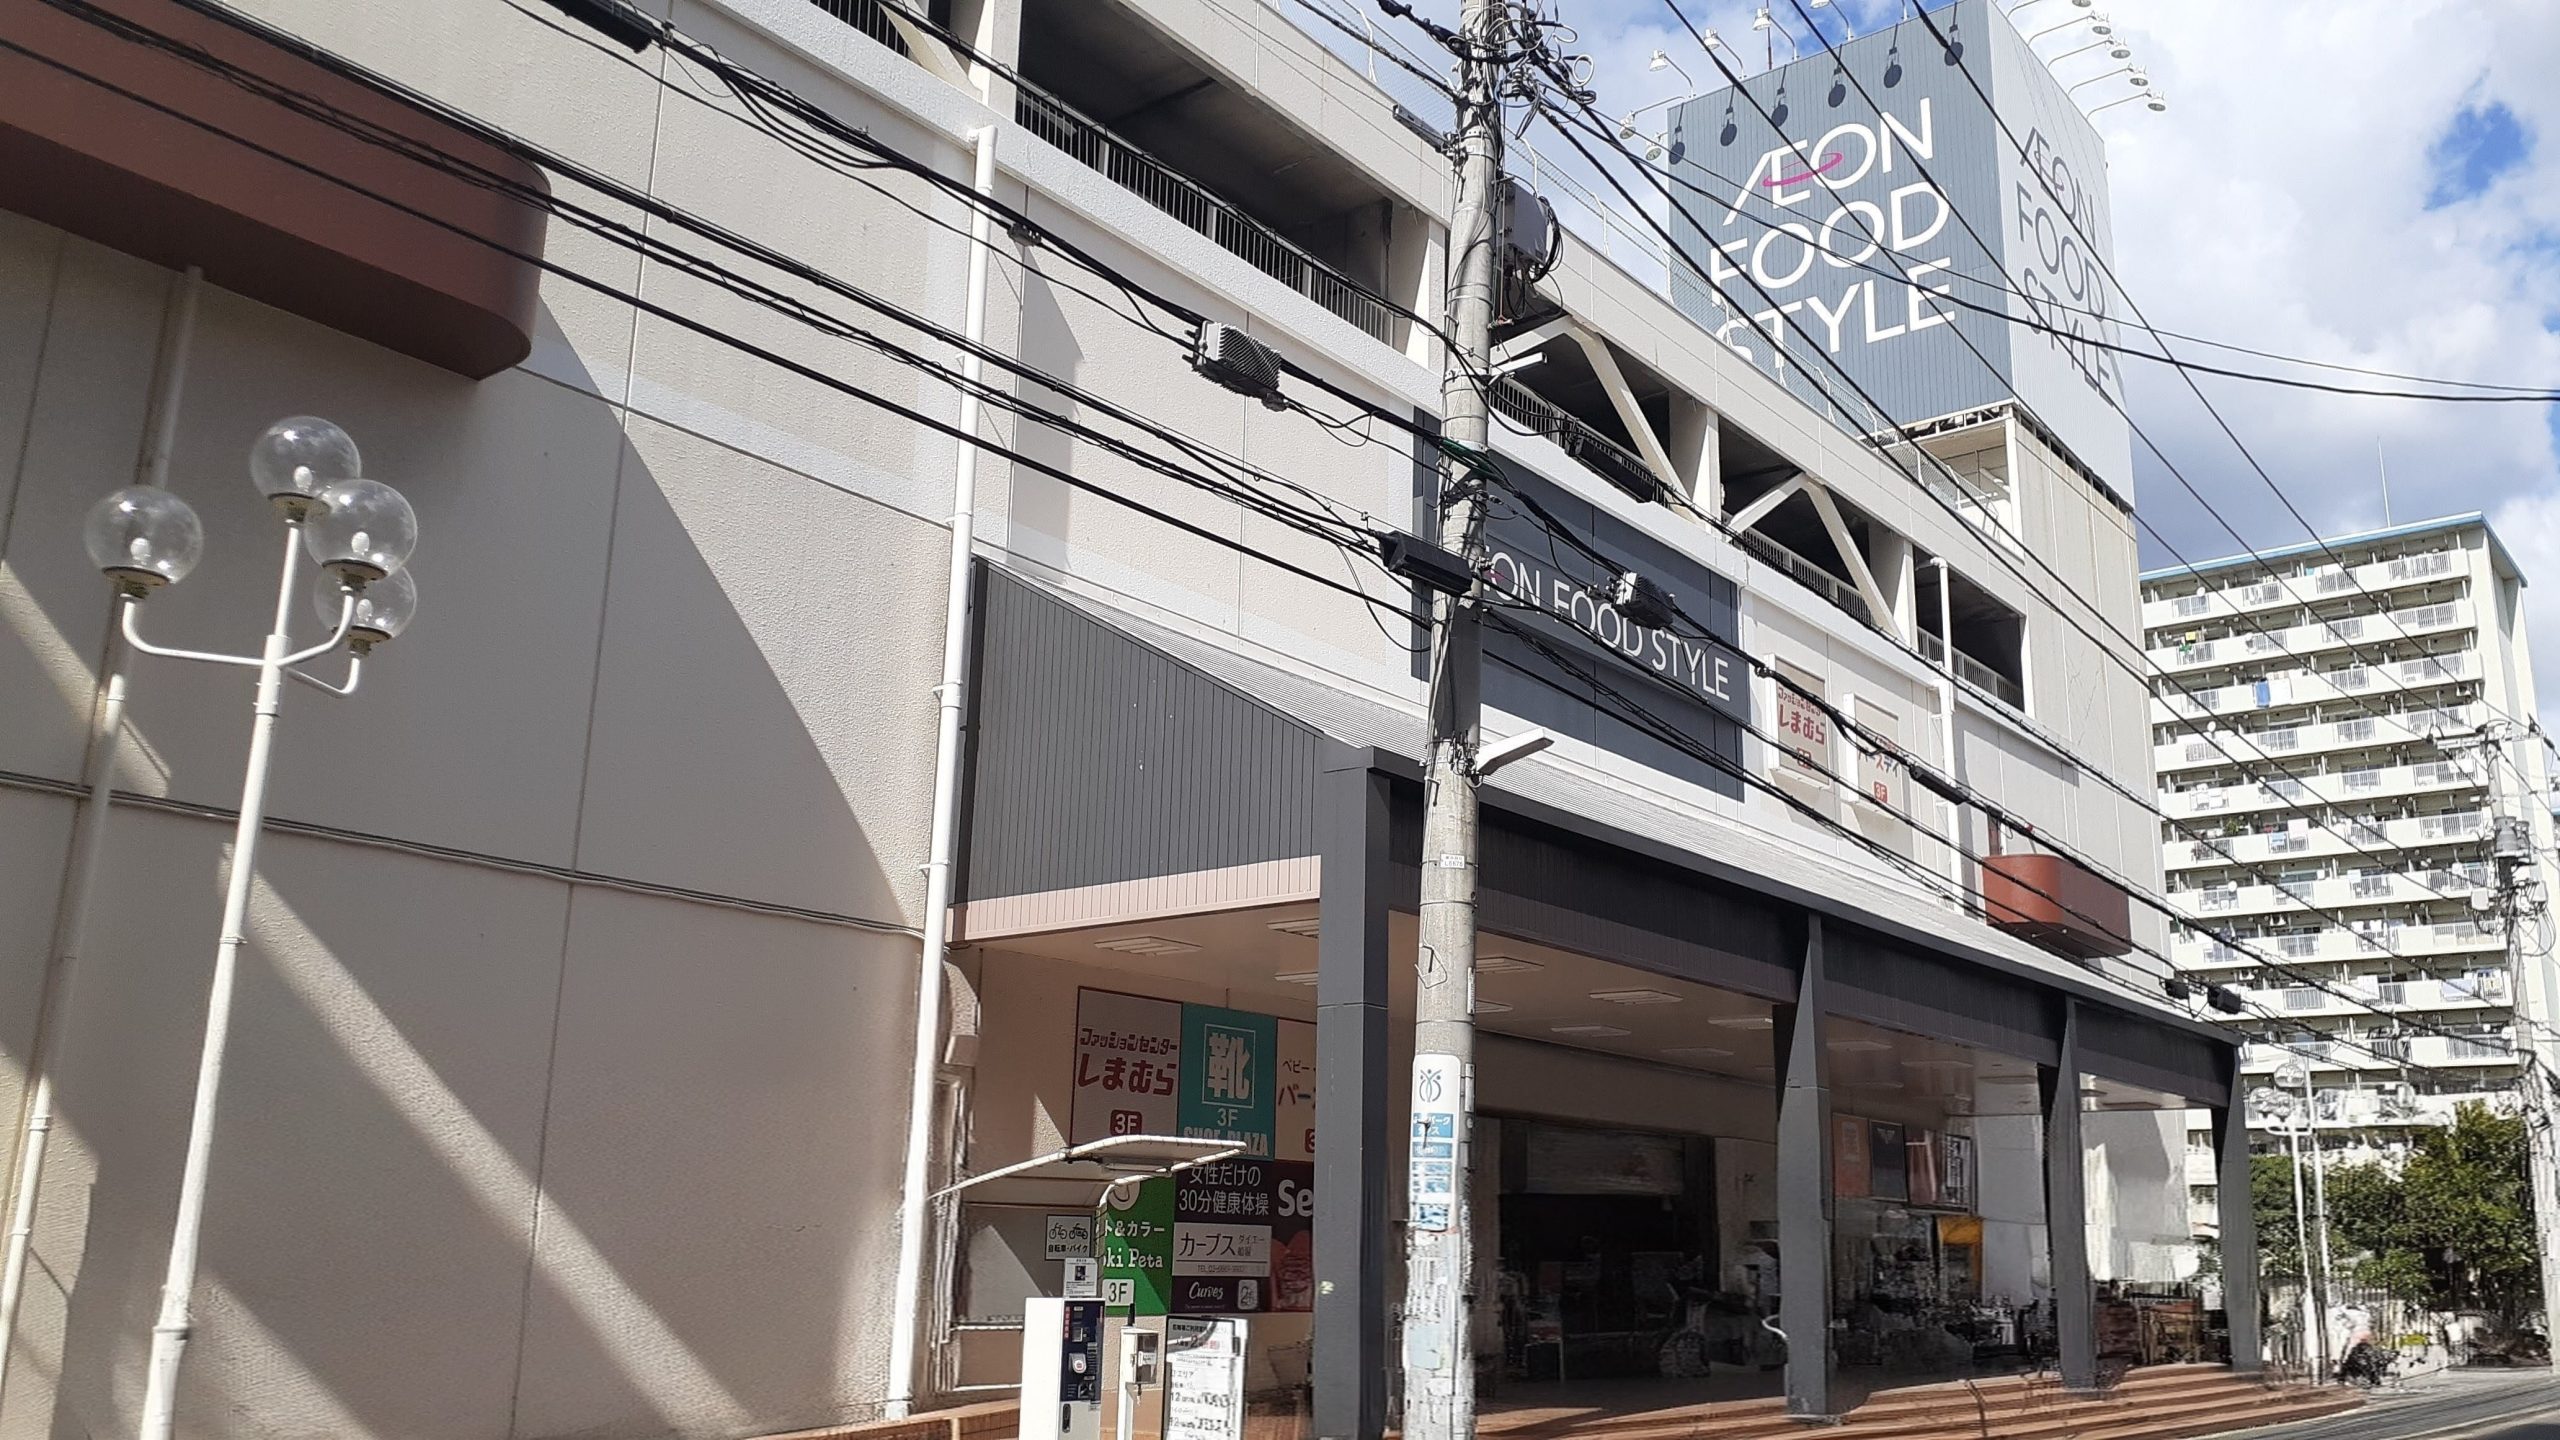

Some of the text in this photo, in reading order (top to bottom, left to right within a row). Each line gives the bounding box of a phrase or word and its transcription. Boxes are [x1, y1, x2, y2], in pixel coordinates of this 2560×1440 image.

[1710, 181, 1950, 307] FOOD
[2016, 180, 2105, 323] FOOD
[2024, 267, 2114, 408] STYLE
[1483, 546, 1730, 701] ON FOOD STYLE
[1779, 704, 1825, 745] しまむら
[1080, 1027, 1178, 1055] ファッションセンター
[1077, 1053, 1177, 1096] しまむら
[1207, 1032, 1251, 1100] 靴
[1278, 1083, 1316, 1110] バー
[1114, 1113, 1138, 1134] 3F
[1217, 1108, 1239, 1127] 3F
[1189, 1162, 1261, 1187] 女性だけの
[1178, 1188, 1269, 1216] 30分健康体操
[1048, 1244, 1089, 1253] 自転車・バイク
[1103, 1247, 1163, 1268] ki Peta
[1179, 1232, 1236, 1257] カーブス
[1108, 1282, 1128, 1303] 3F
[1189, 1281, 1224, 1300] Curves
